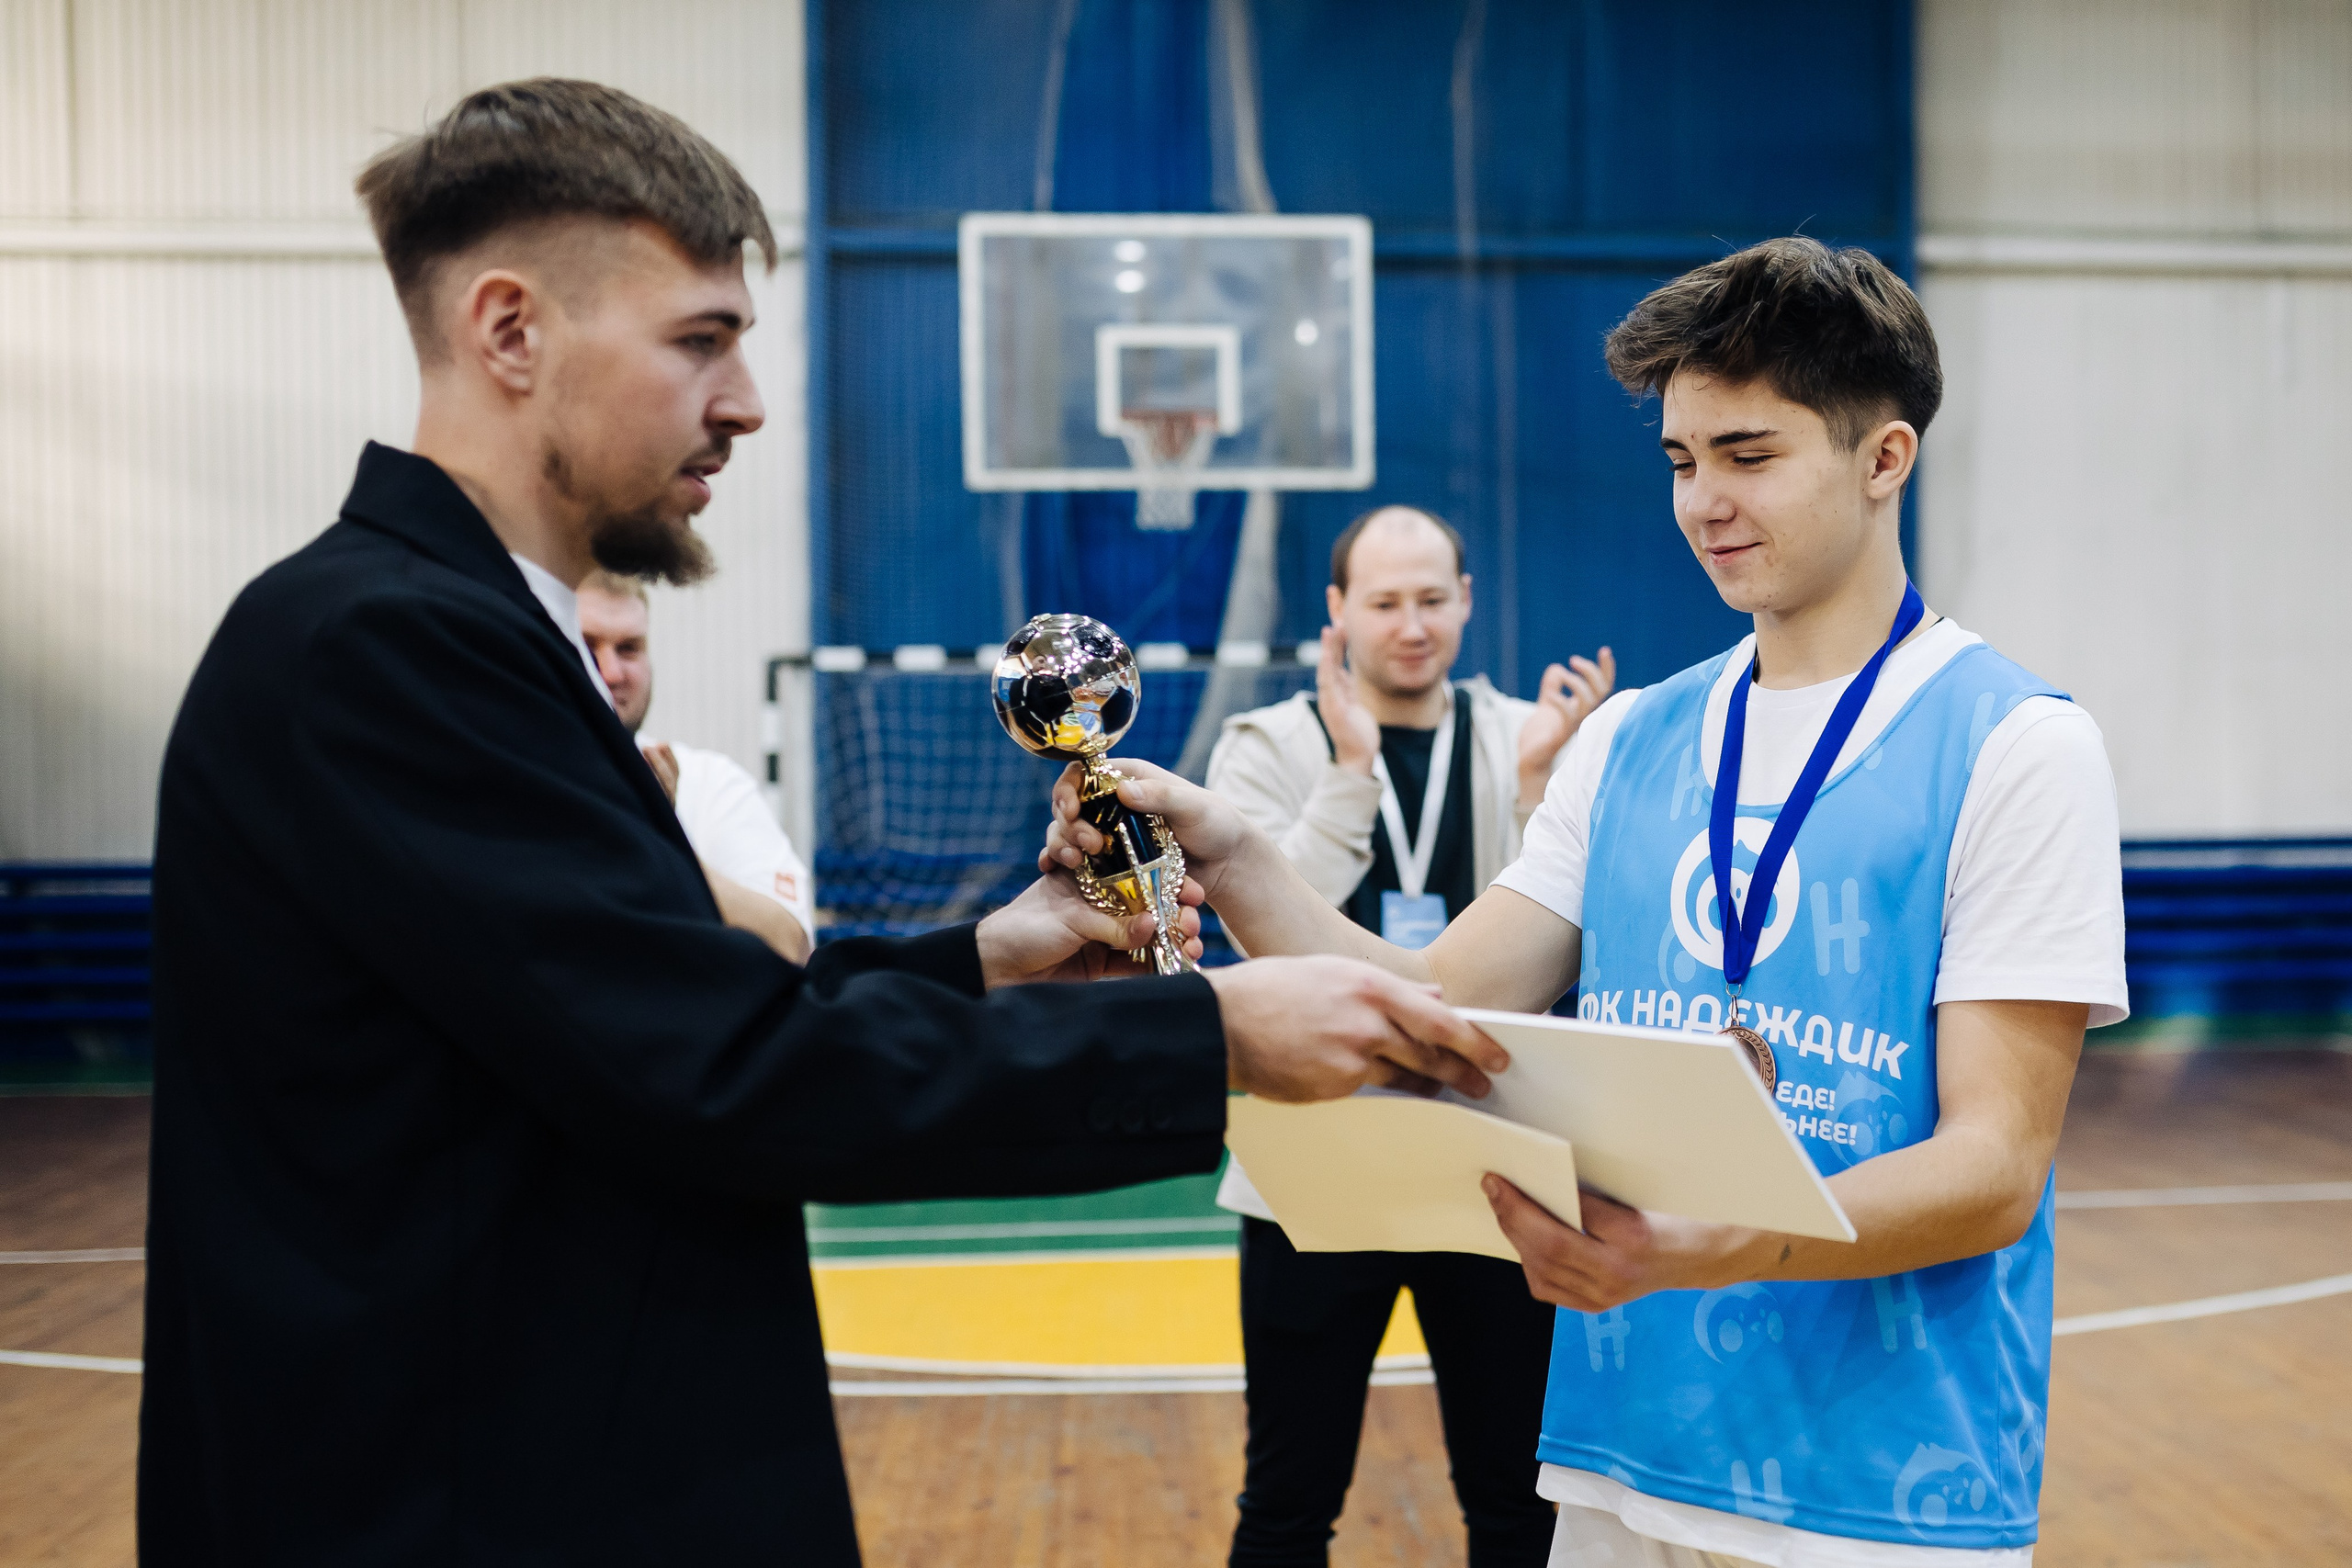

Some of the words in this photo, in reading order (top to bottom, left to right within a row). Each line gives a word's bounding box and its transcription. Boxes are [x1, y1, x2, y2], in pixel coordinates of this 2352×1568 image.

[1578, 989, 1623, 1025] ФК
[1632, 989, 1910, 1080] НАДЕЖДИК
[1775, 1080, 1837, 1111] ЕДЕ!
[1780, 1111, 1858, 1145] ЬНЕЕ!
